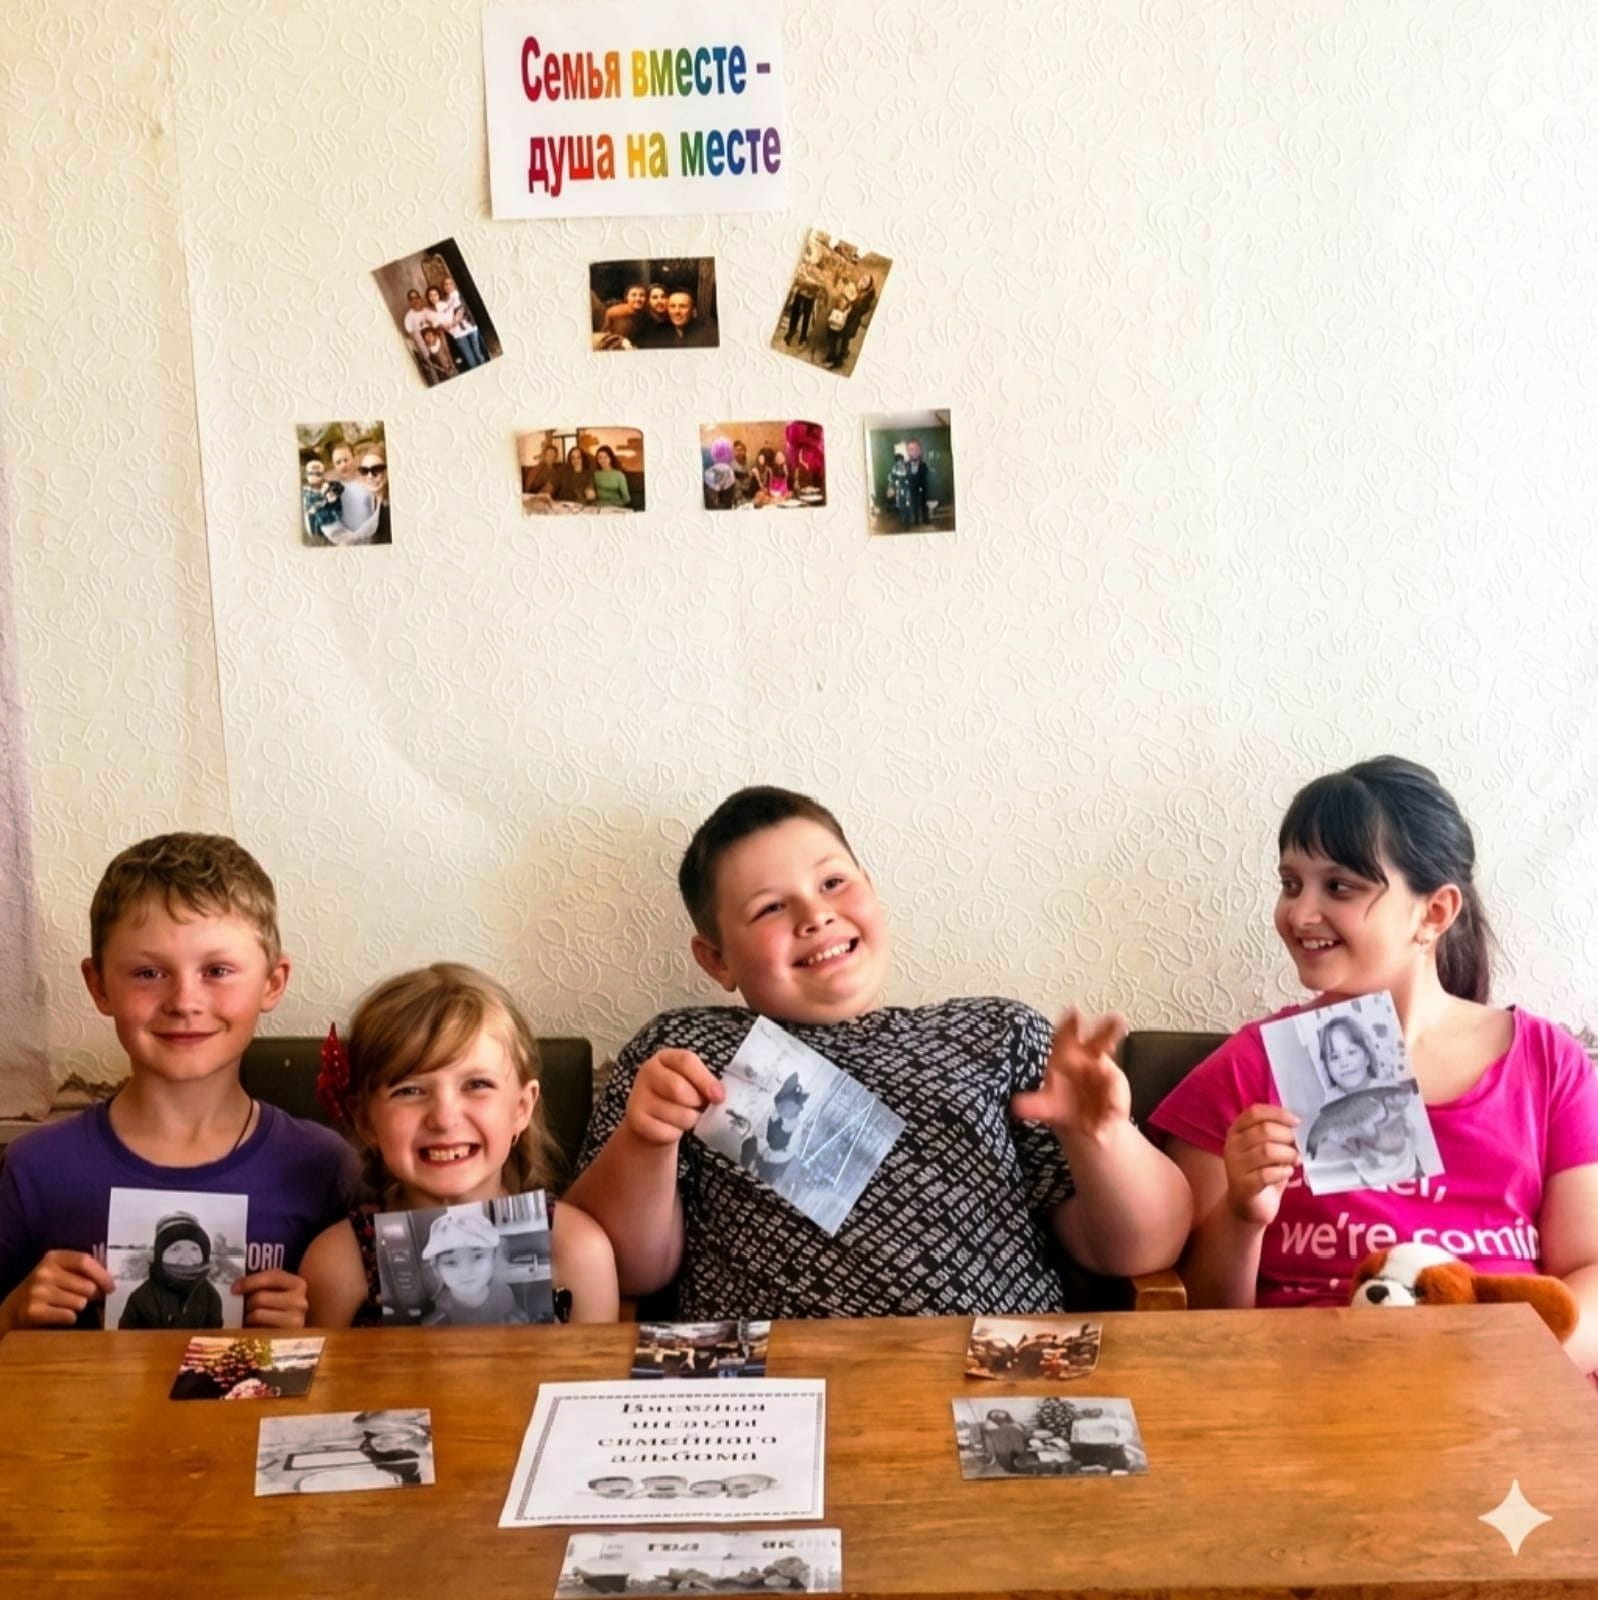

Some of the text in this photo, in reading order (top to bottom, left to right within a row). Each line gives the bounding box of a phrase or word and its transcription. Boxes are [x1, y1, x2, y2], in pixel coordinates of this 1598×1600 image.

[521, 36, 621, 102] Семья
[631, 45, 747, 98] вместе
[528, 127, 782, 198] душа на месте
[1281, 1212, 1398, 1259] we're
